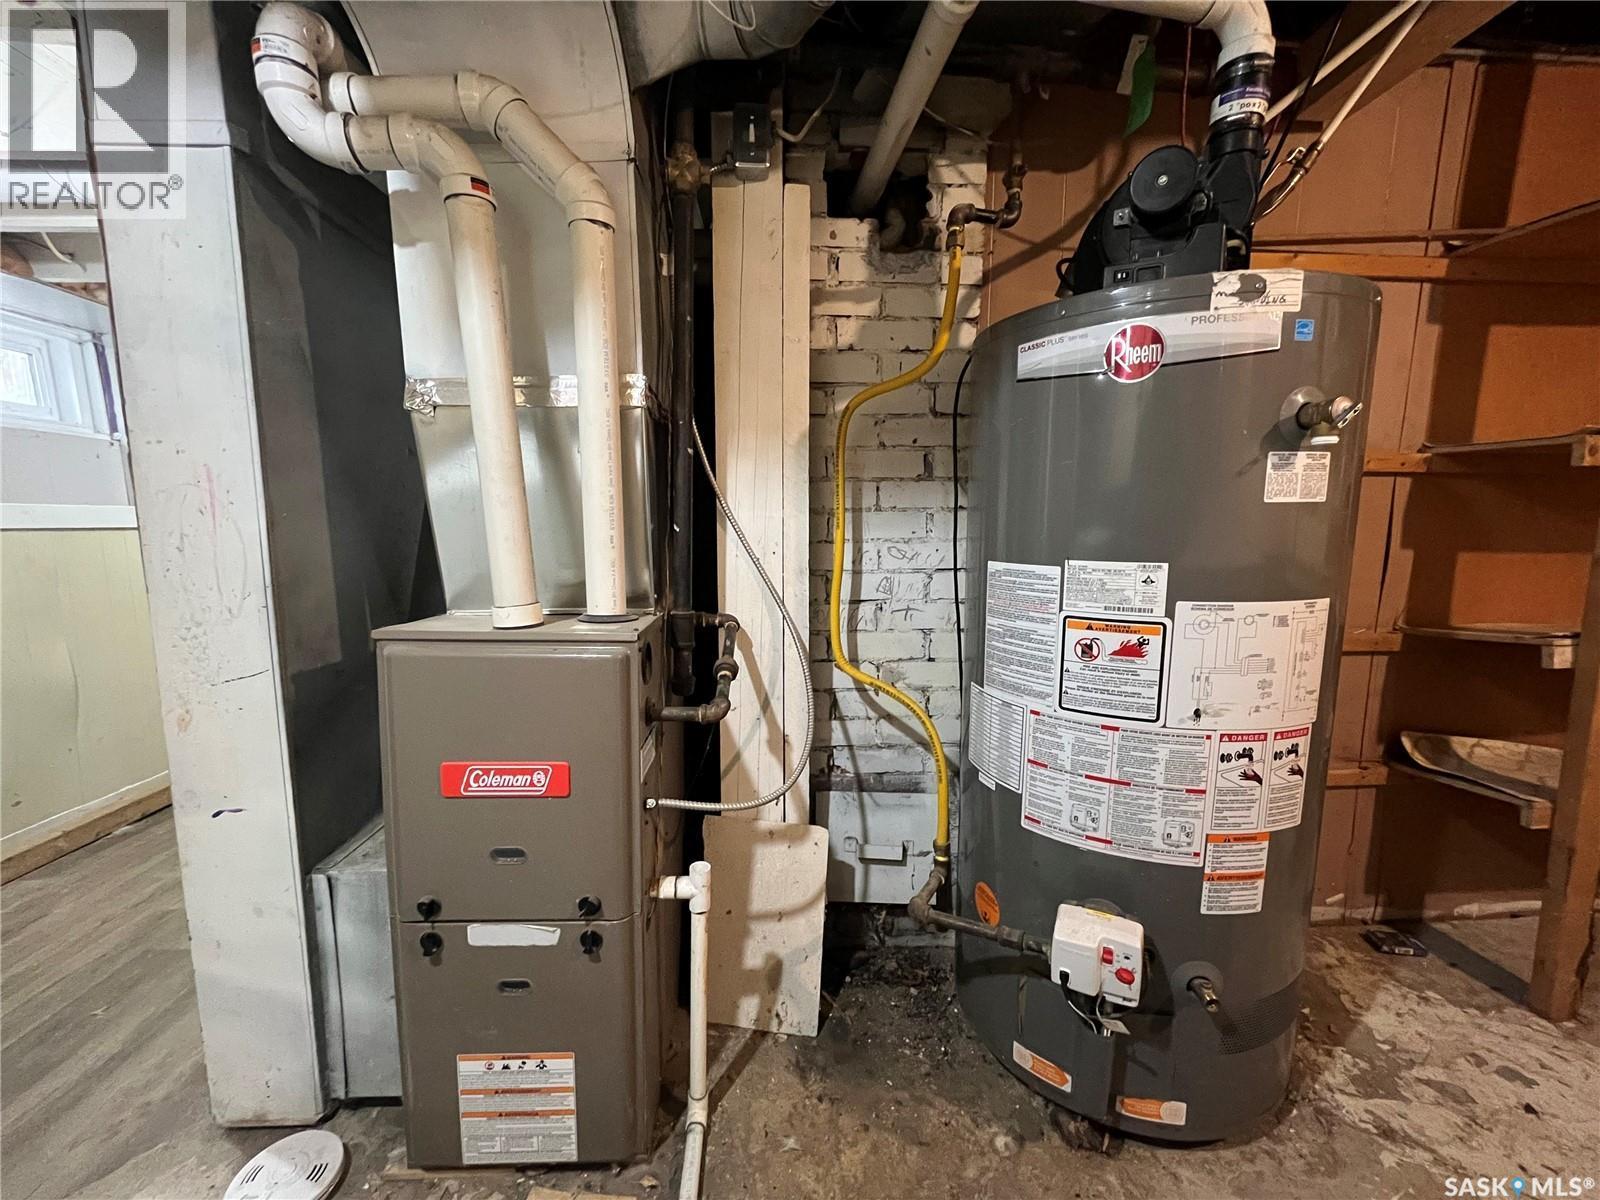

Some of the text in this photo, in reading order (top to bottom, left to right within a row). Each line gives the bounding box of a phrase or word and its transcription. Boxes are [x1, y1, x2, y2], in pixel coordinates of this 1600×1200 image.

[1020, 340, 1046, 354] CLASSIC
[1110, 325, 1162, 374] Rheem
[1282, 728, 1308, 738] DANGER
[469, 769, 532, 788] Coleman
